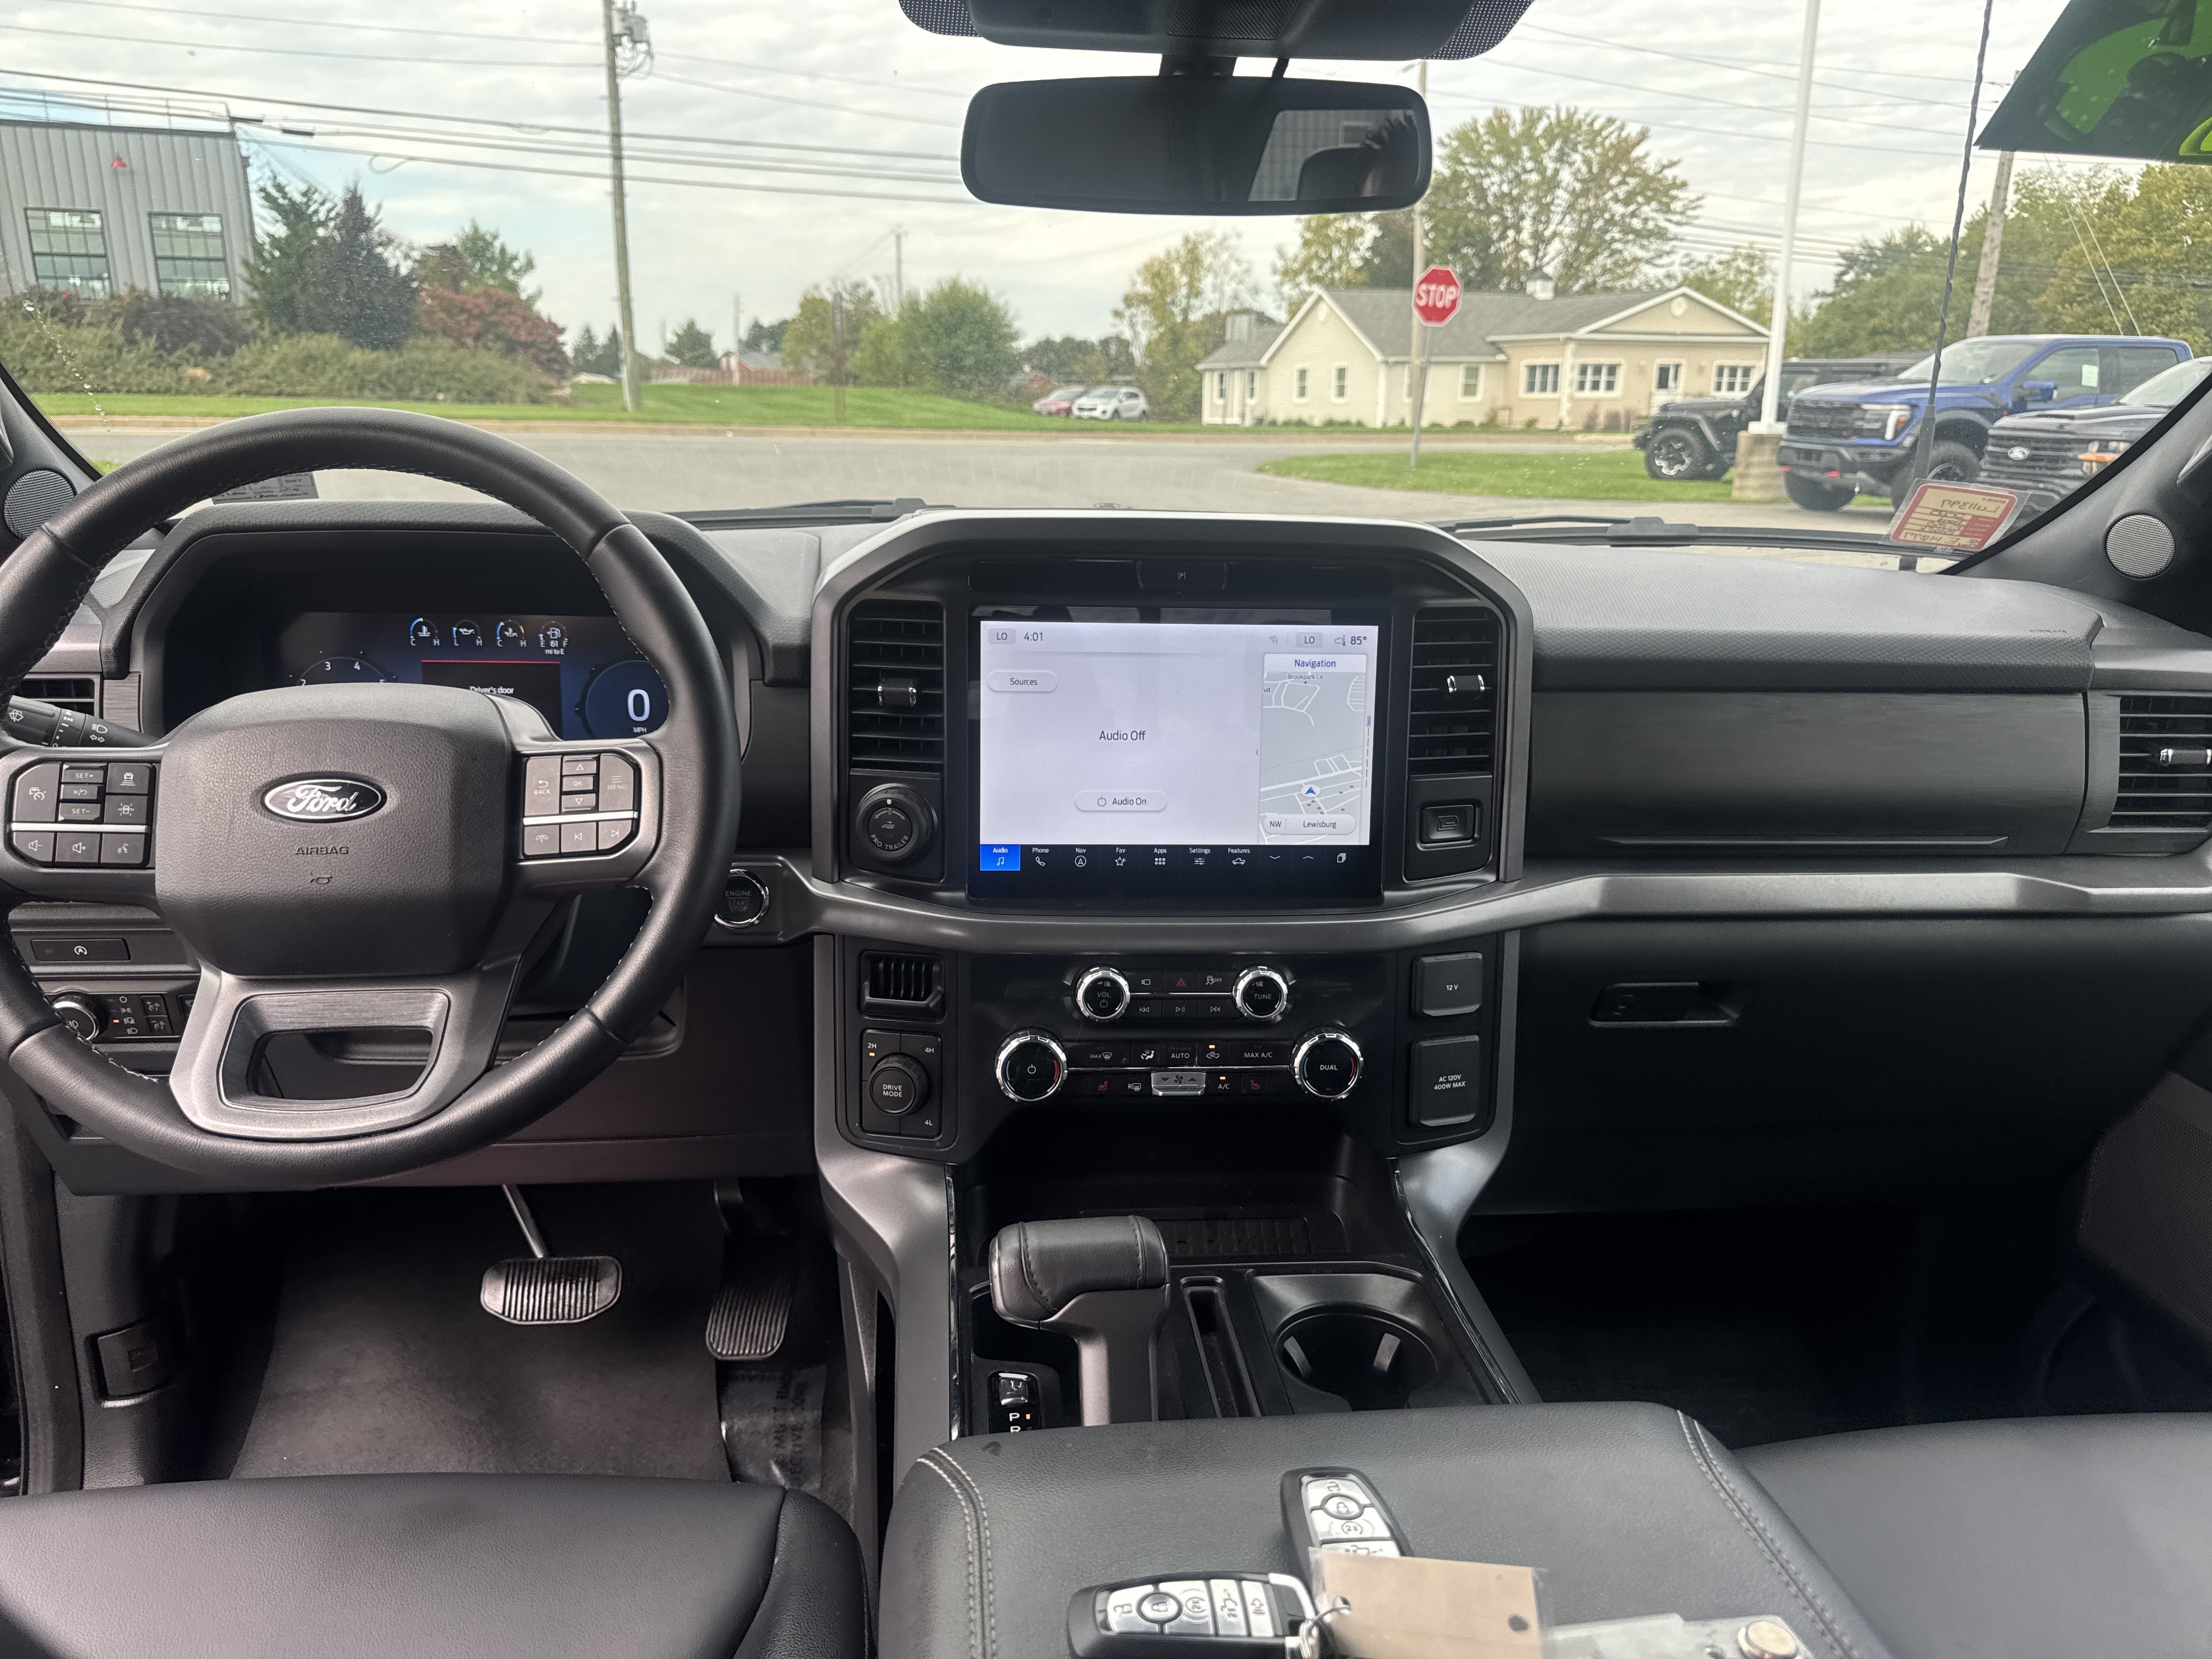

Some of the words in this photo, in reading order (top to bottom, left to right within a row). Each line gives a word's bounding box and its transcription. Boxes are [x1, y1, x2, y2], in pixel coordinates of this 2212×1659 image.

[1416, 283, 1458, 308] STOP
[996, 632, 1008, 641] LO
[1024, 631, 1043, 641] 4:01
[1305, 636, 1315, 644] LO
[1350, 636, 1367, 645] 85°
[325, 661, 331, 670] 3
[354, 661, 360, 670] 4
[1294, 659, 1336, 669] Navigation
[1009, 678, 1038, 686] Sources
[627, 689, 650, 721] 0
[1099, 730, 1128, 741] Audio
[1130, 730, 1147, 741] Off
[287, 785, 359, 812] Ford
[1111, 797, 1134, 805] Audio
[1135, 797, 1147, 805] On
[1303, 820, 1336, 829] Lewisburg
[870, 834, 883, 847] PRO
[885, 835, 910, 850] TRAILER
[295, 846, 349, 855] AIRBAG
[1447, 1074, 1462, 1082] 120V
[1434, 1082, 1452, 1091] 400W
[1452, 1080, 1466, 1088] MAX
[1009, 1412, 1020, 1422] P
